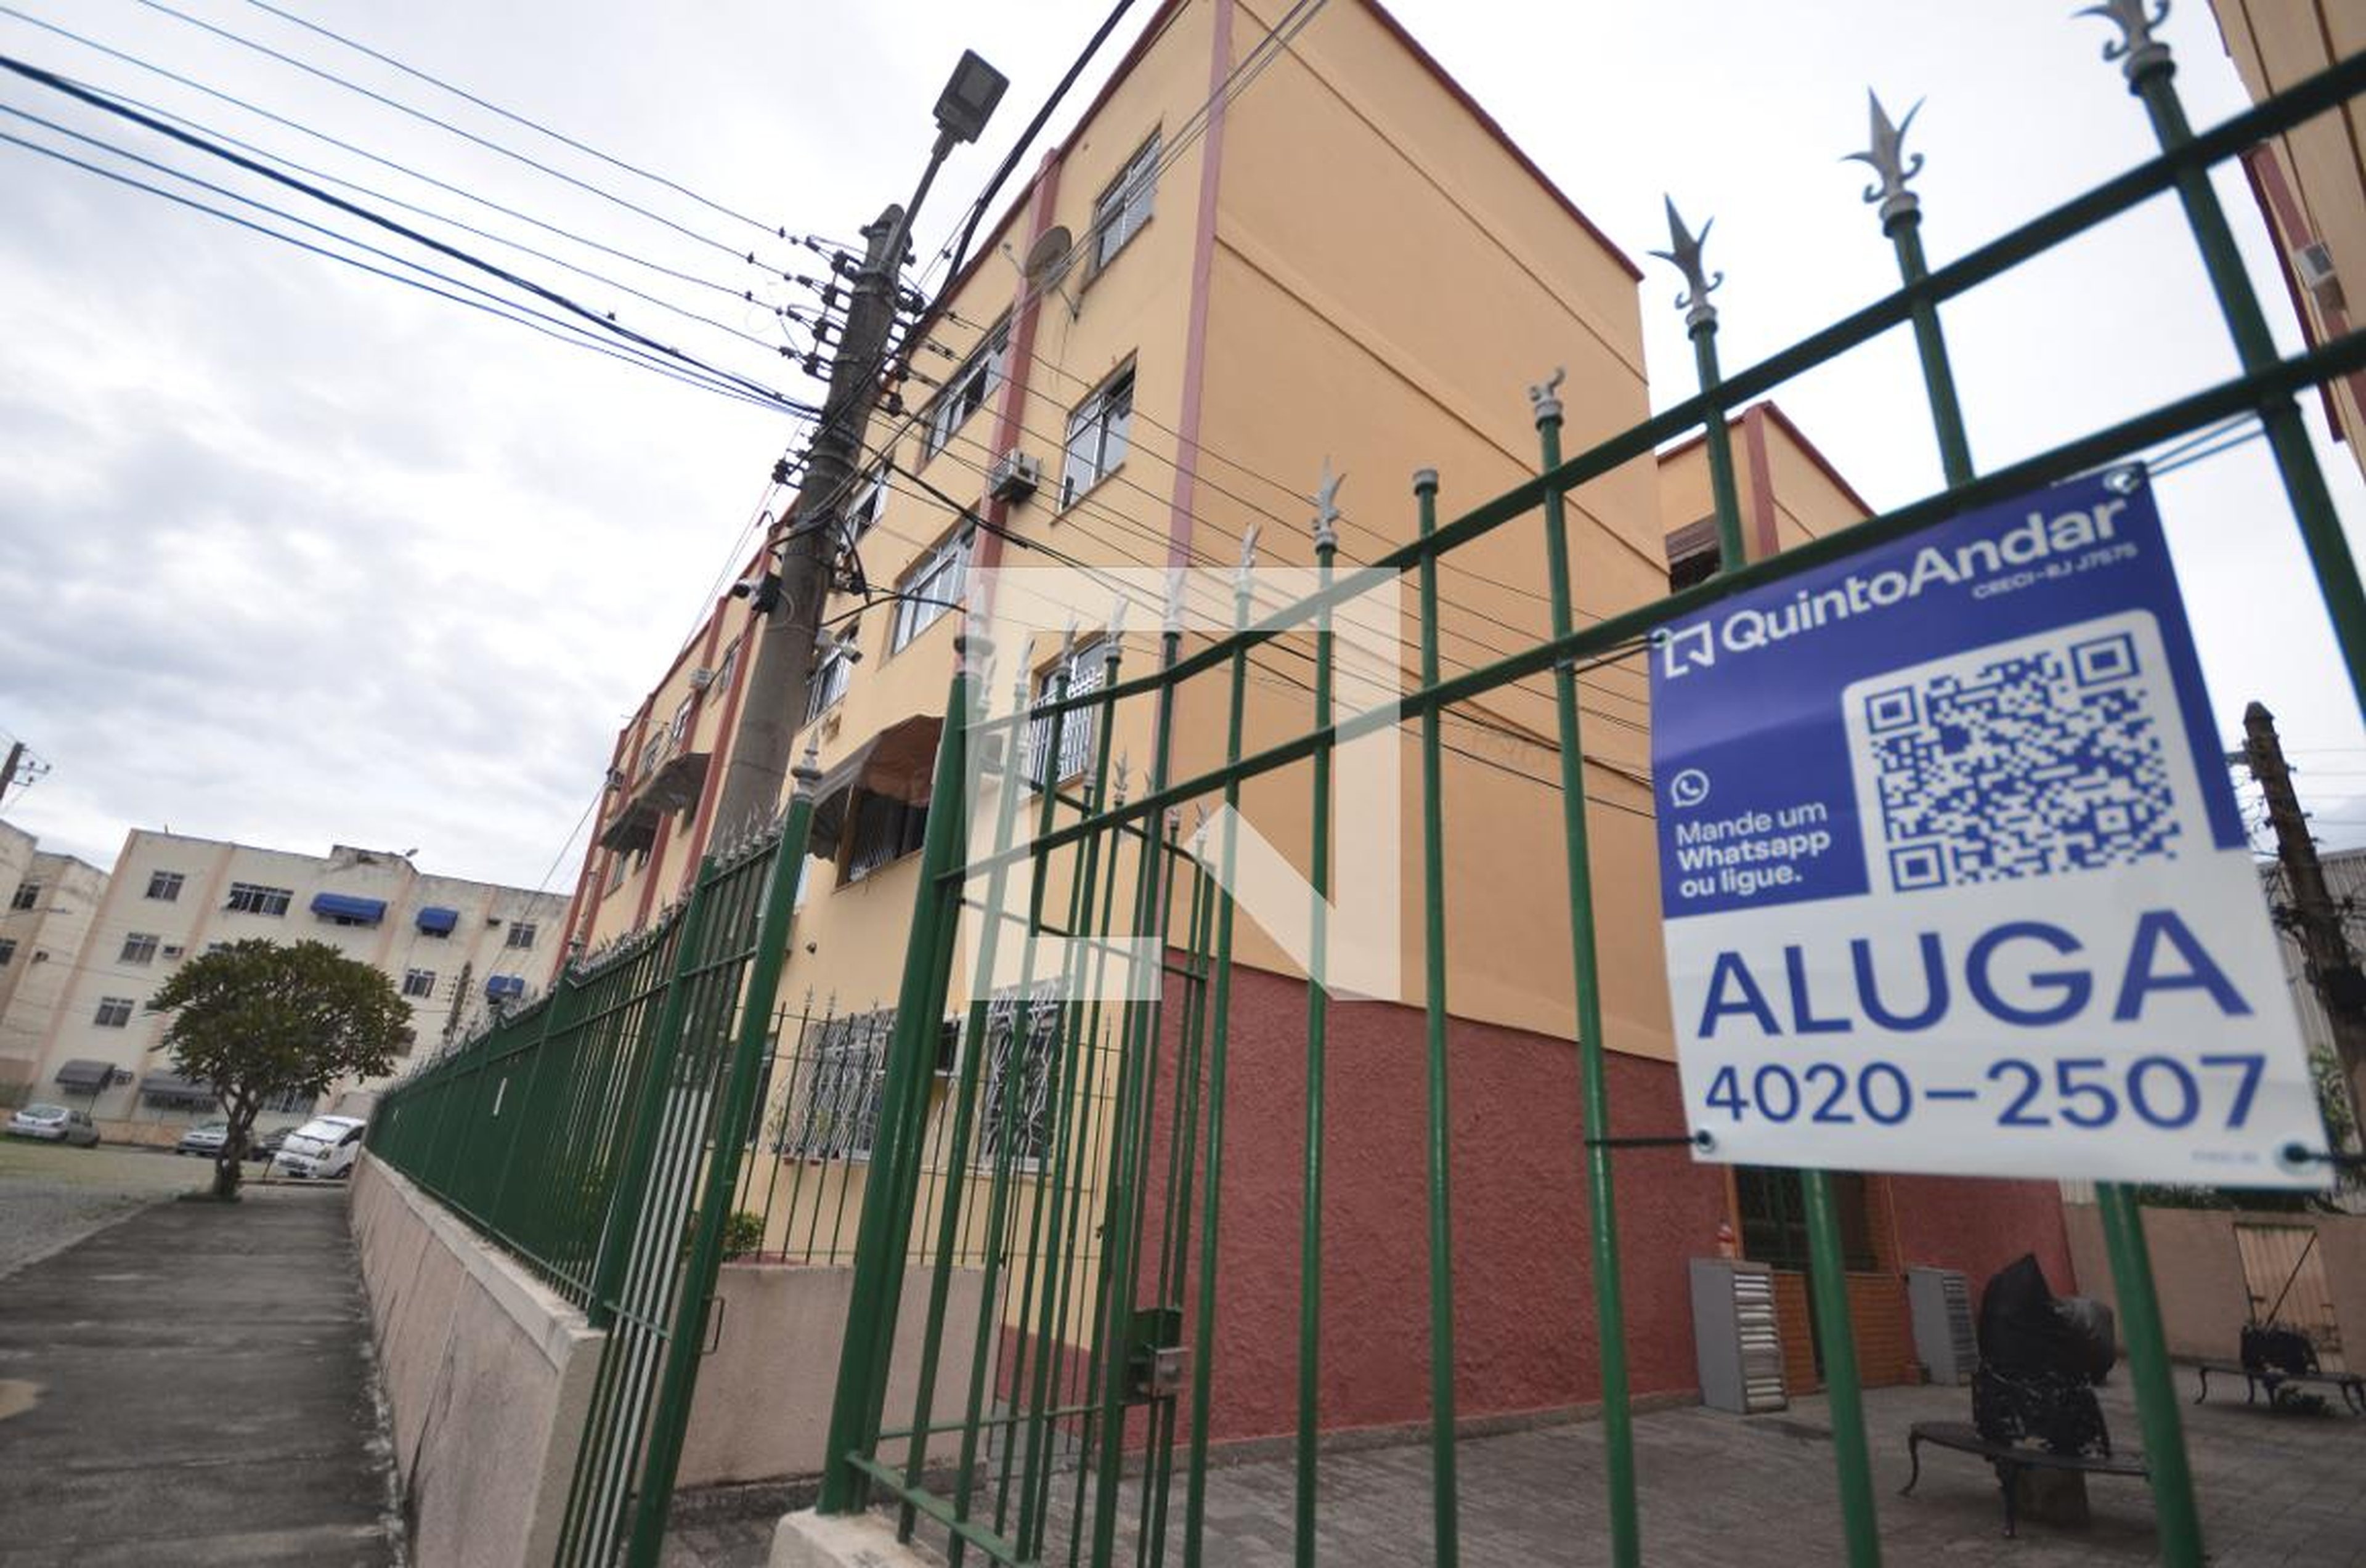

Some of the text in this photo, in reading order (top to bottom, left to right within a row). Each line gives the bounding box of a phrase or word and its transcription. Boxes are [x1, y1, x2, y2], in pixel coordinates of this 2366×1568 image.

[1722, 498, 2127, 654] QuintoAndar
[1675, 802, 1827, 847] Mande um
[1677, 831, 1831, 871] Whatsapp
[1680, 864, 1803, 898] ou ligue.
[1697, 909, 2253, 1038] ALUGA
[1705, 1054, 2267, 1130] 4020-2507
